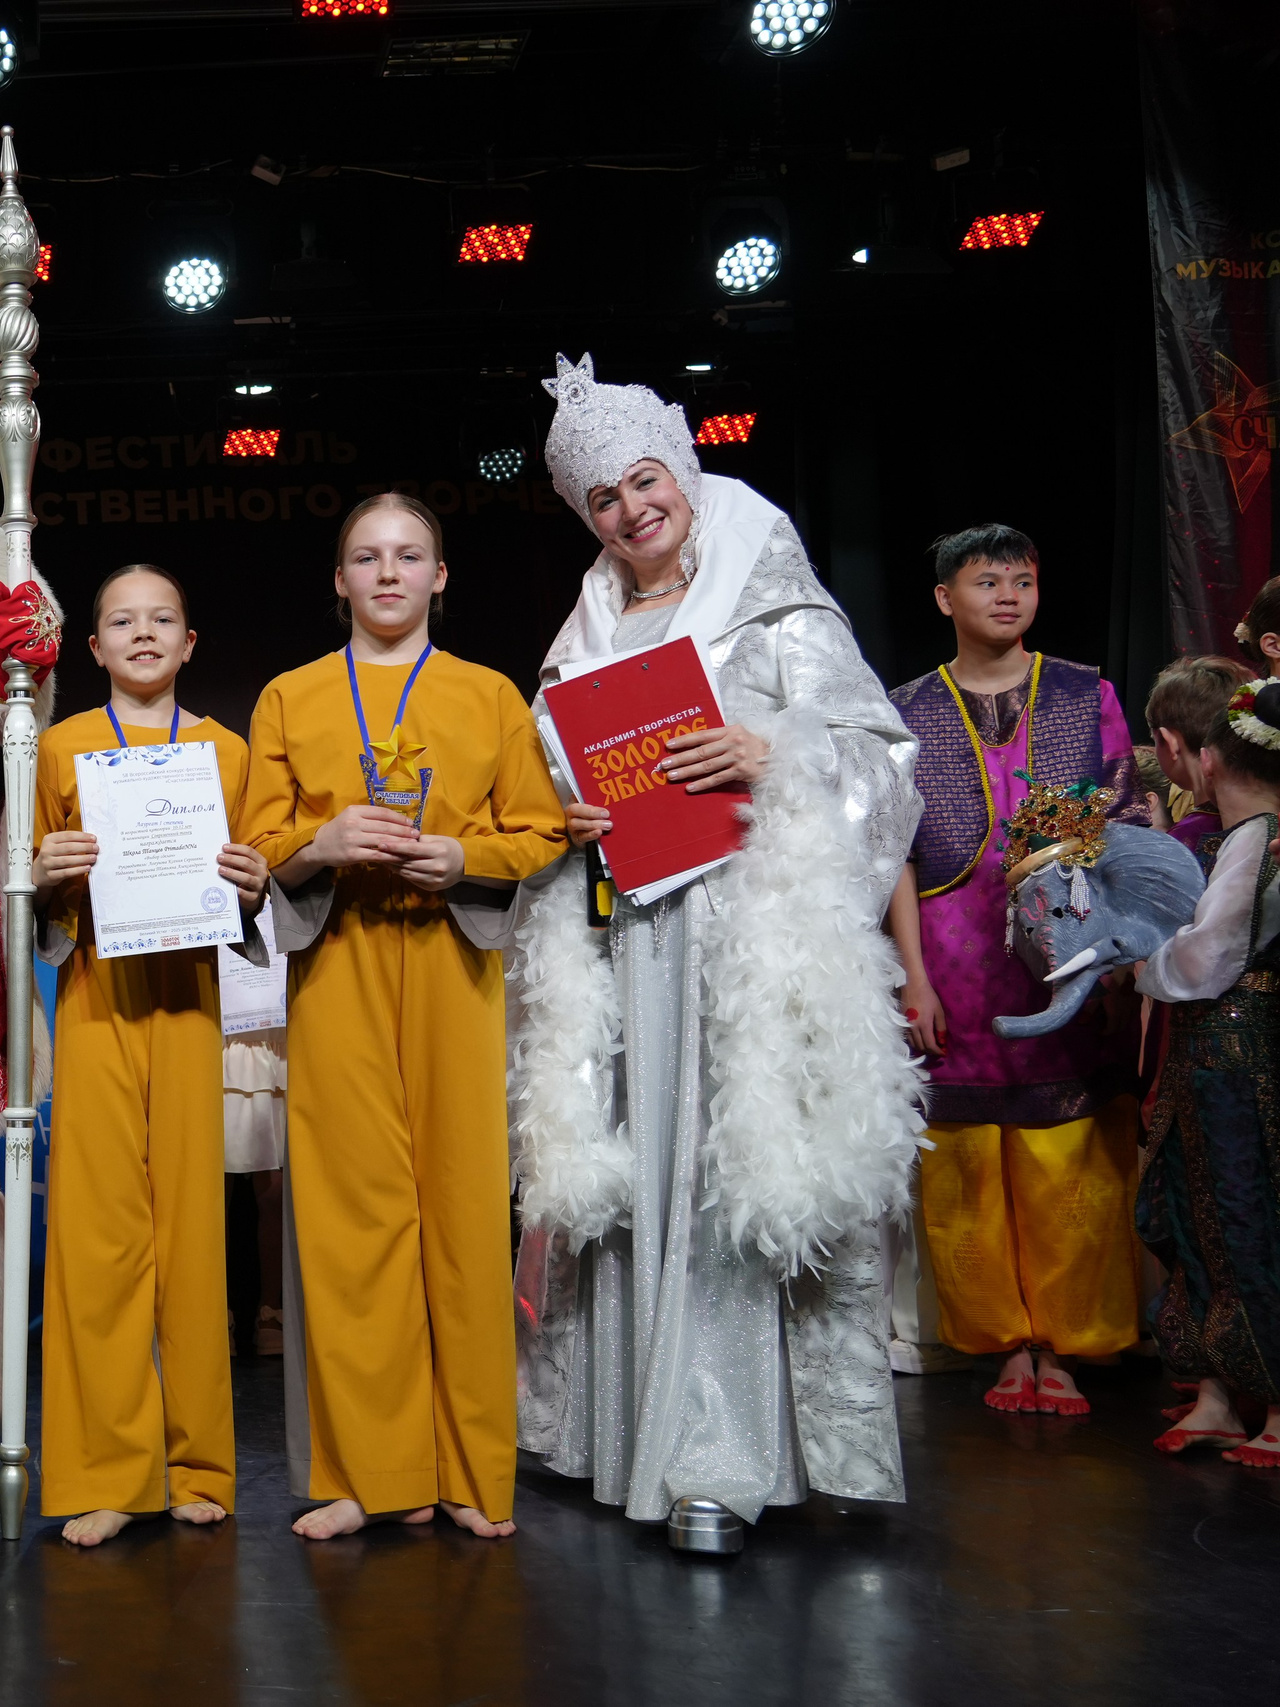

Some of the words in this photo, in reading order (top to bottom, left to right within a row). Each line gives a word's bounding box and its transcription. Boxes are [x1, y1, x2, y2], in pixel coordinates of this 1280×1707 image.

[583, 729, 637, 755] АКАДЕМИЯ
[638, 705, 702, 734] ТВОРЧЕСТВА
[145, 798, 216, 817] Диплом
